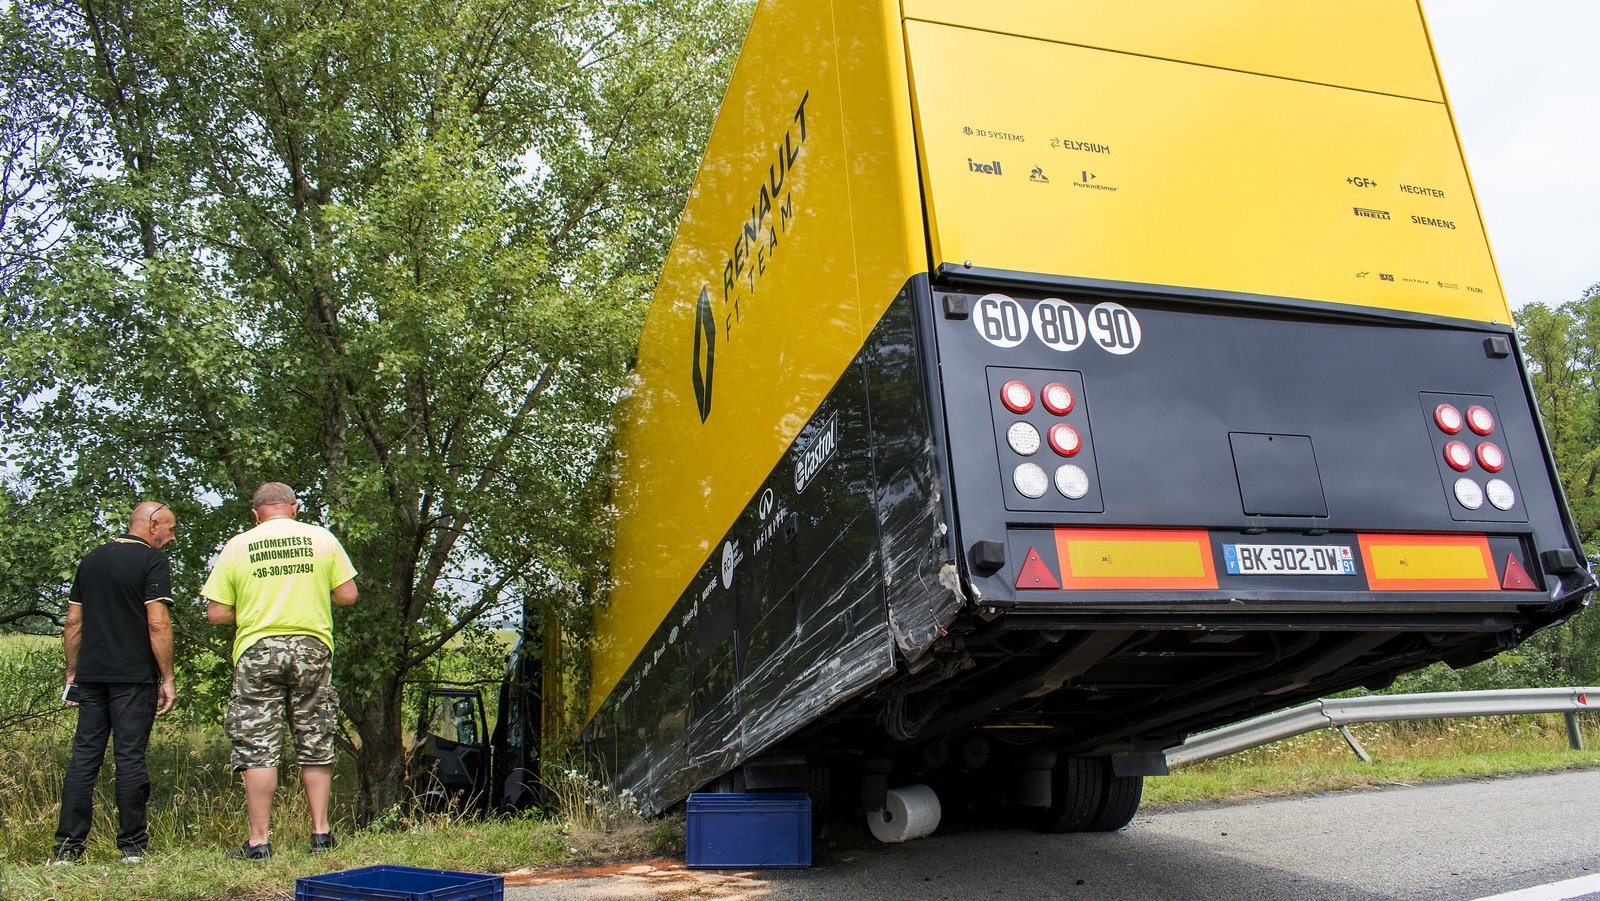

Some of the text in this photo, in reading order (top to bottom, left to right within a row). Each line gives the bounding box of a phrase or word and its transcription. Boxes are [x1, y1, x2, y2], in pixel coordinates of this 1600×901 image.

[975, 128, 1025, 142] 3D SYSTEMS
[1063, 139, 1110, 154] ELYSIUM
[967, 157, 1002, 175] ixell
[723, 89, 809, 304] RENAULT
[1399, 183, 1445, 199] HECHTER
[1353, 207, 1391, 221] PIRELLI
[1411, 215, 1456, 230] SIEMENS
[748, 192, 792, 294] TEAM
[980, 299, 1022, 342] 60
[1038, 303, 1079, 345] 80
[1094, 307, 1135, 349] 90
[803, 418, 836, 482] Castrol
[249, 546, 314, 564] KAMIONMENTÉS
[252, 563, 314, 579] +36-30/9372494
[1344, 560, 1355, 572] 91
